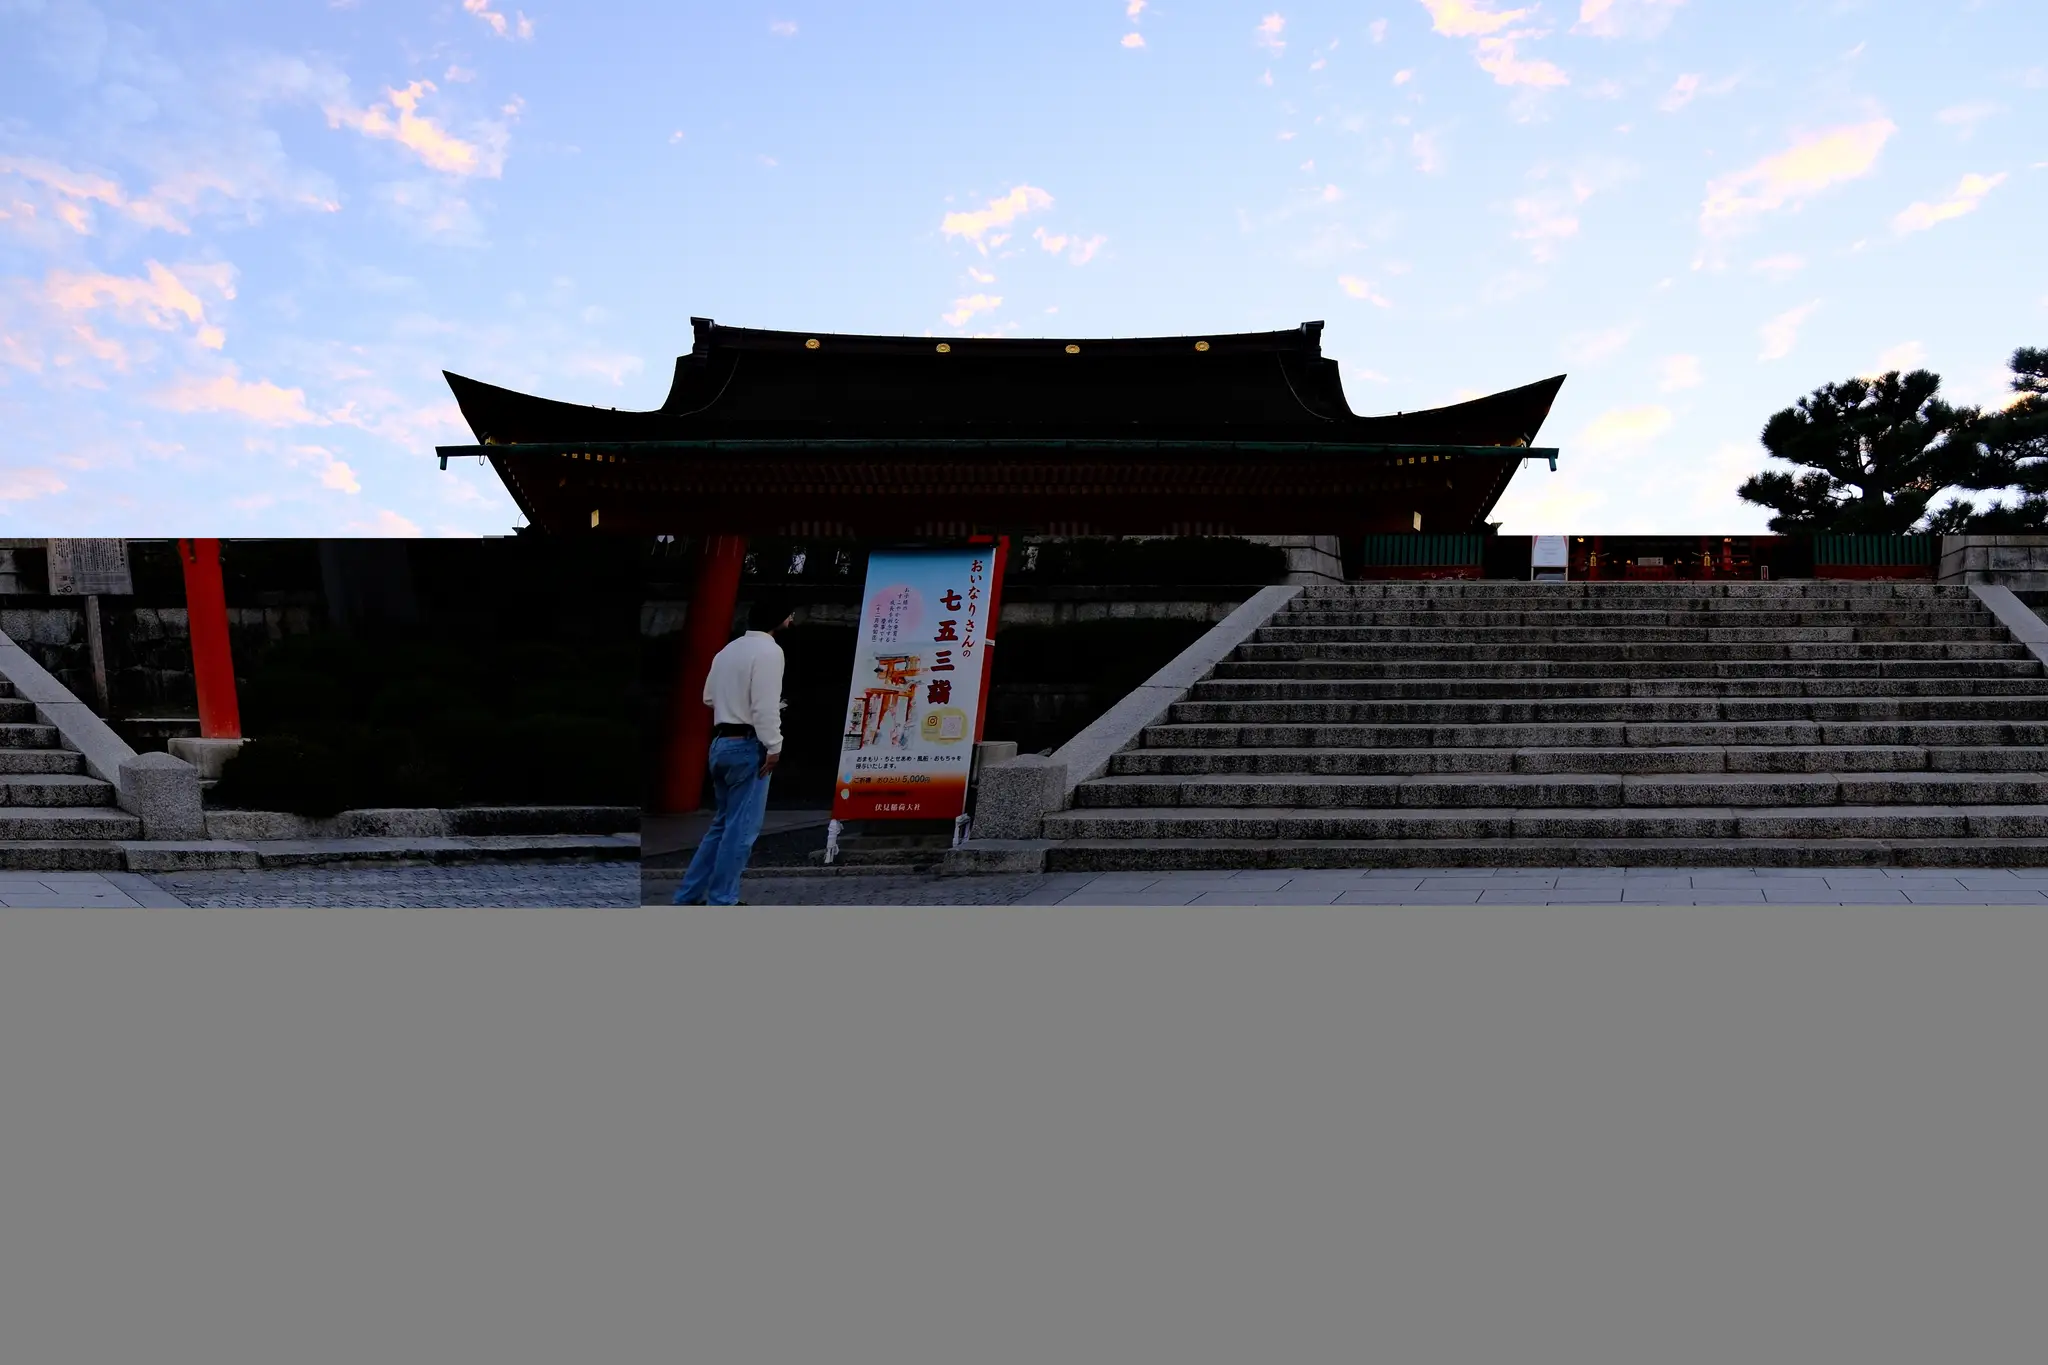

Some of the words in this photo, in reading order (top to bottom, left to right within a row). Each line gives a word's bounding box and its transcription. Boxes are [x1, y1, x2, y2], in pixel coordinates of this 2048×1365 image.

[902, 587, 910, 611] お子様の
[961, 559, 983, 658] おいなりさんの
[874, 803, 921, 812] 伏見稲荷大社
